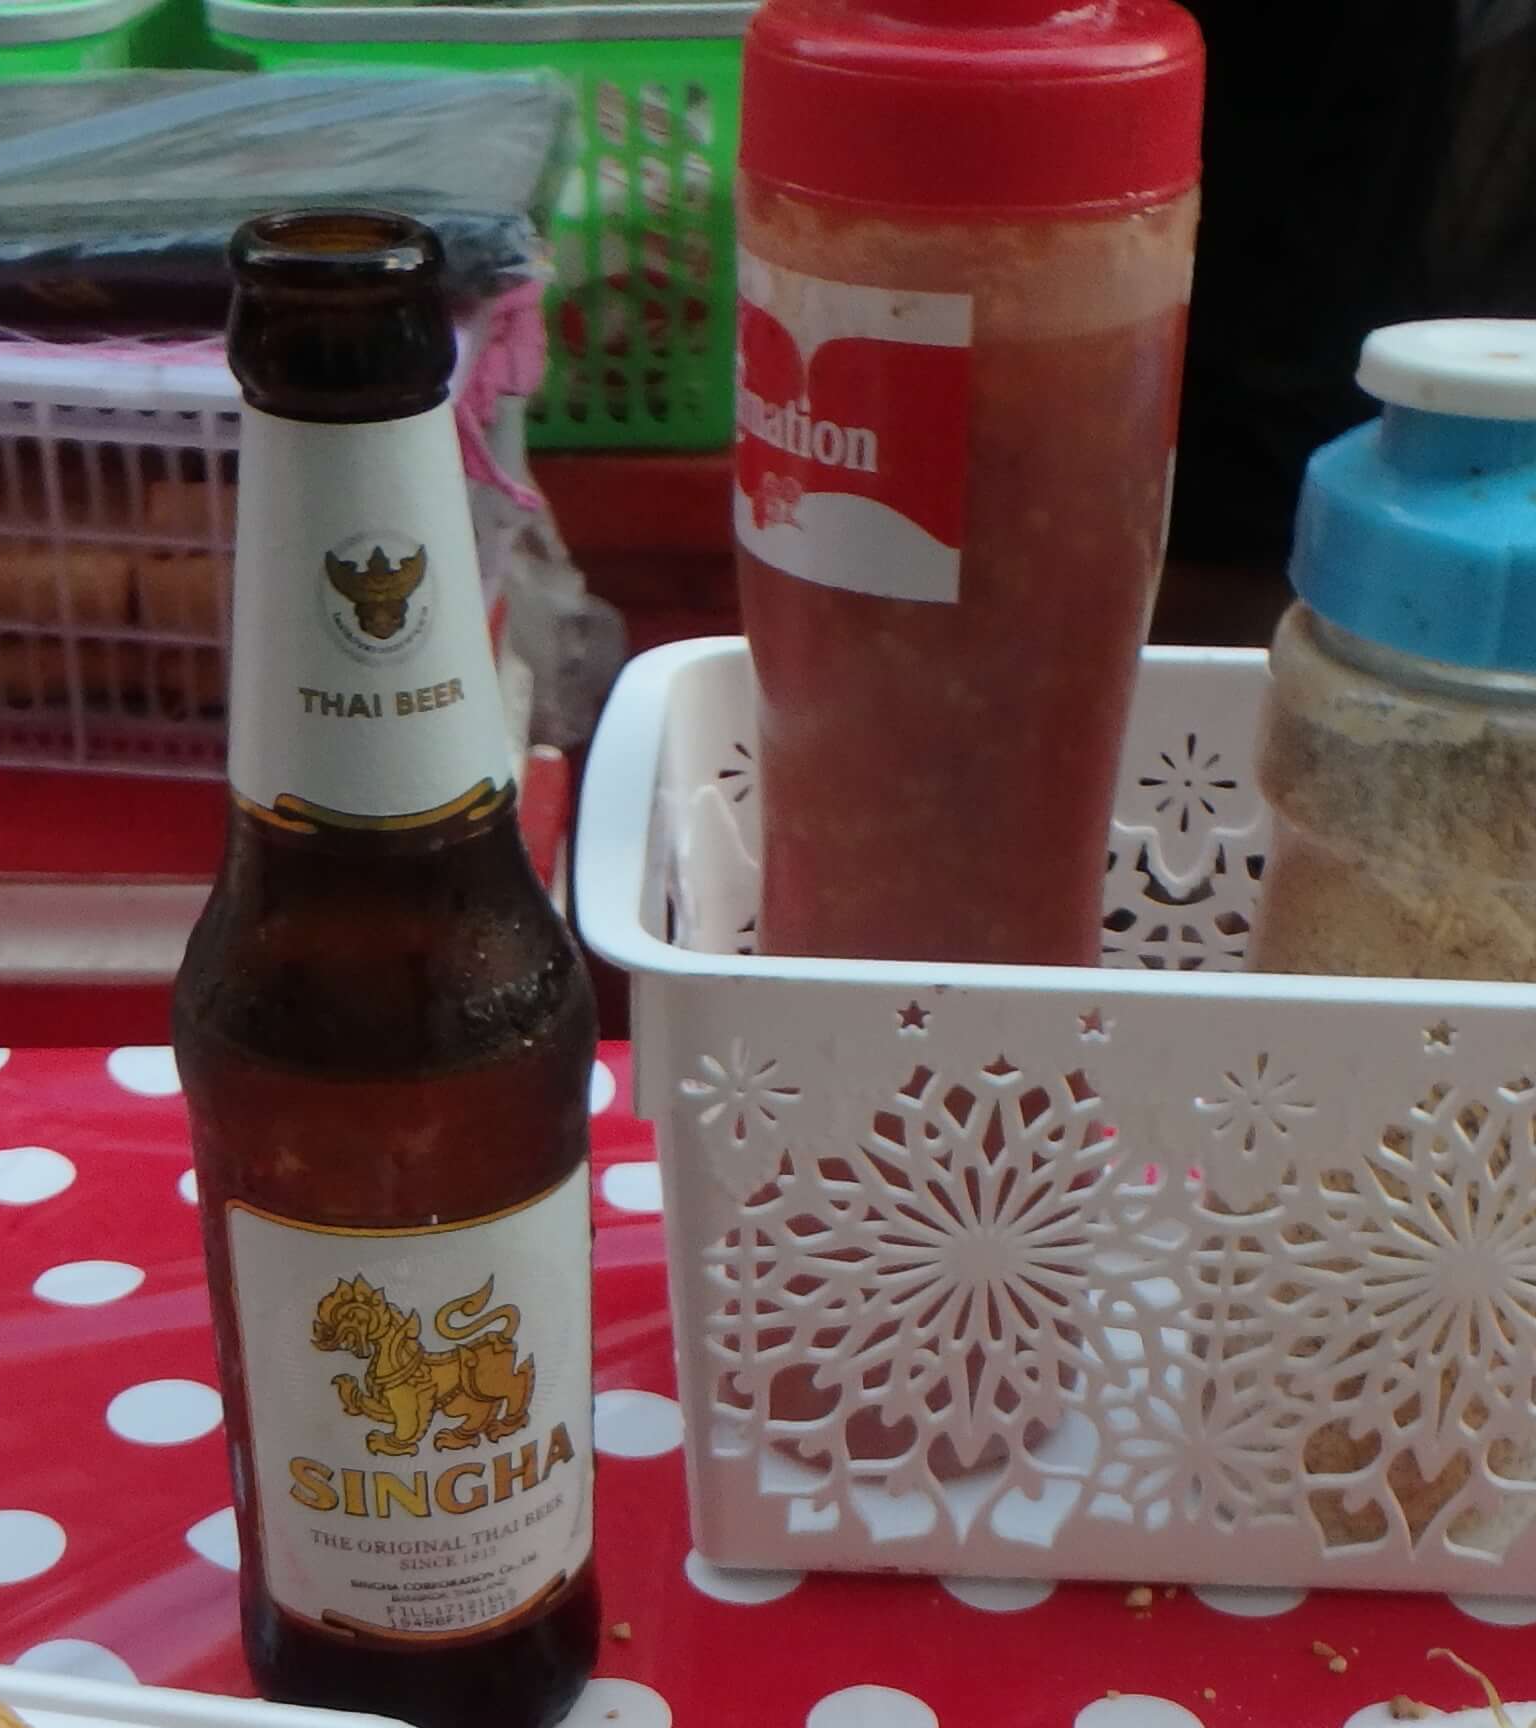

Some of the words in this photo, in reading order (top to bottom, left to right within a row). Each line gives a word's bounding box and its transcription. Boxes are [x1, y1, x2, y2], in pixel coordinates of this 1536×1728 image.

[298, 687, 382, 718] THAI
[393, 678, 464, 716] BEER
[289, 1422, 575, 1518] SINGHA
[310, 1528, 353, 1552] THE
[357, 1535, 467, 1555] ORIGINAL
[472, 1521, 519, 1546] THAI
[399, 1556, 457, 1571] SINCE
